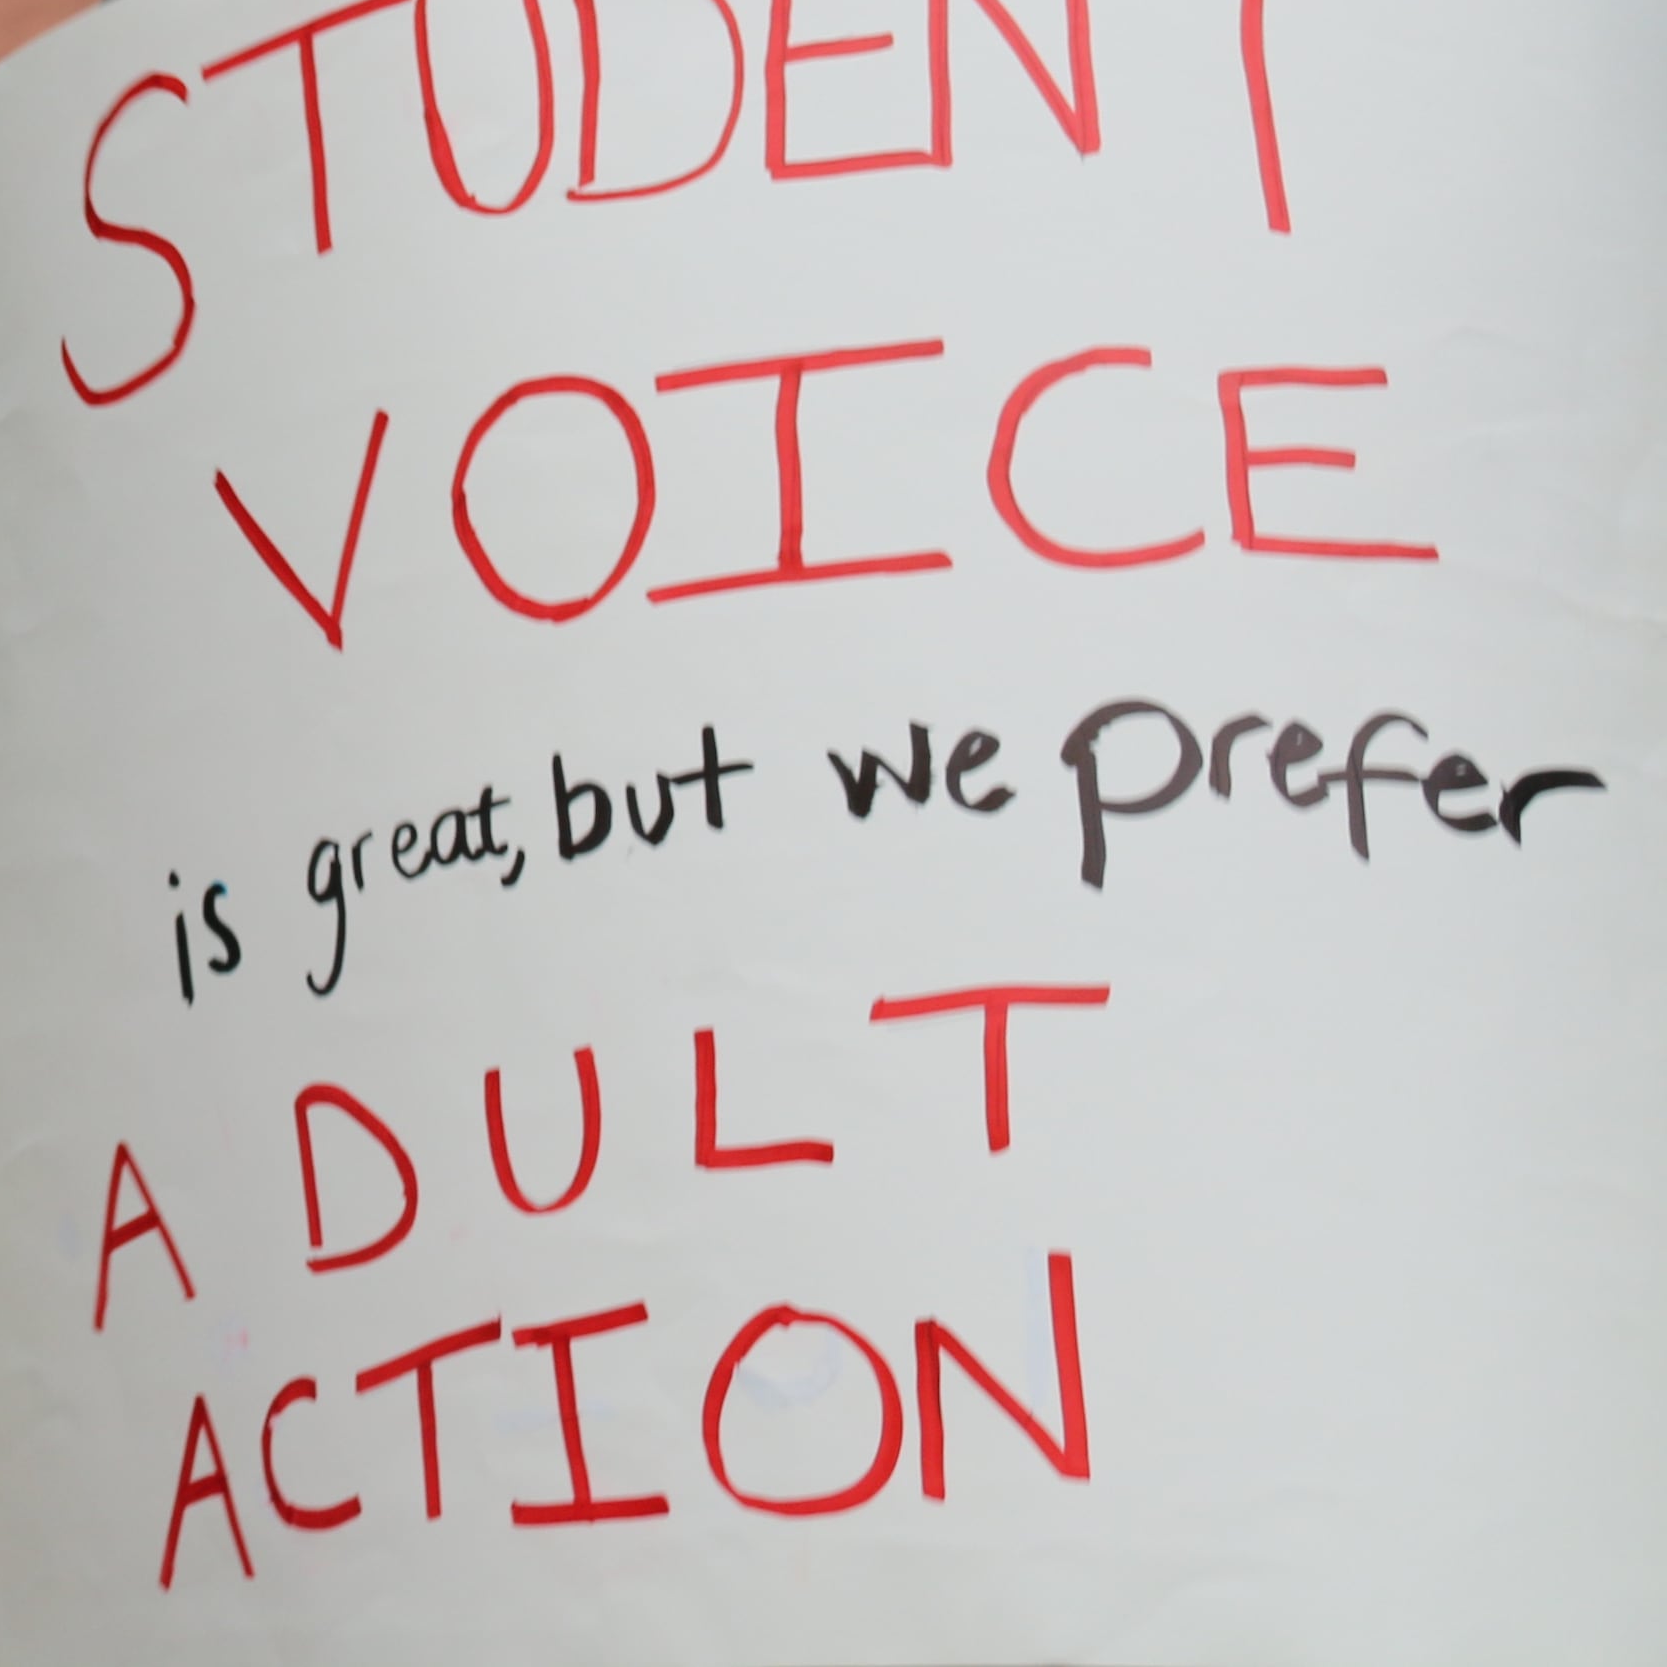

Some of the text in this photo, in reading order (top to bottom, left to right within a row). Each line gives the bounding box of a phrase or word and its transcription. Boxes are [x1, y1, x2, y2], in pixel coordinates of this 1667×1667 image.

[214, 337, 1441, 654] VOICE
[166, 697, 1609, 1006] is great, but we prefer
[91, 981, 1111, 1332] ADULT
[158, 1248, 1092, 1593] ACTION
